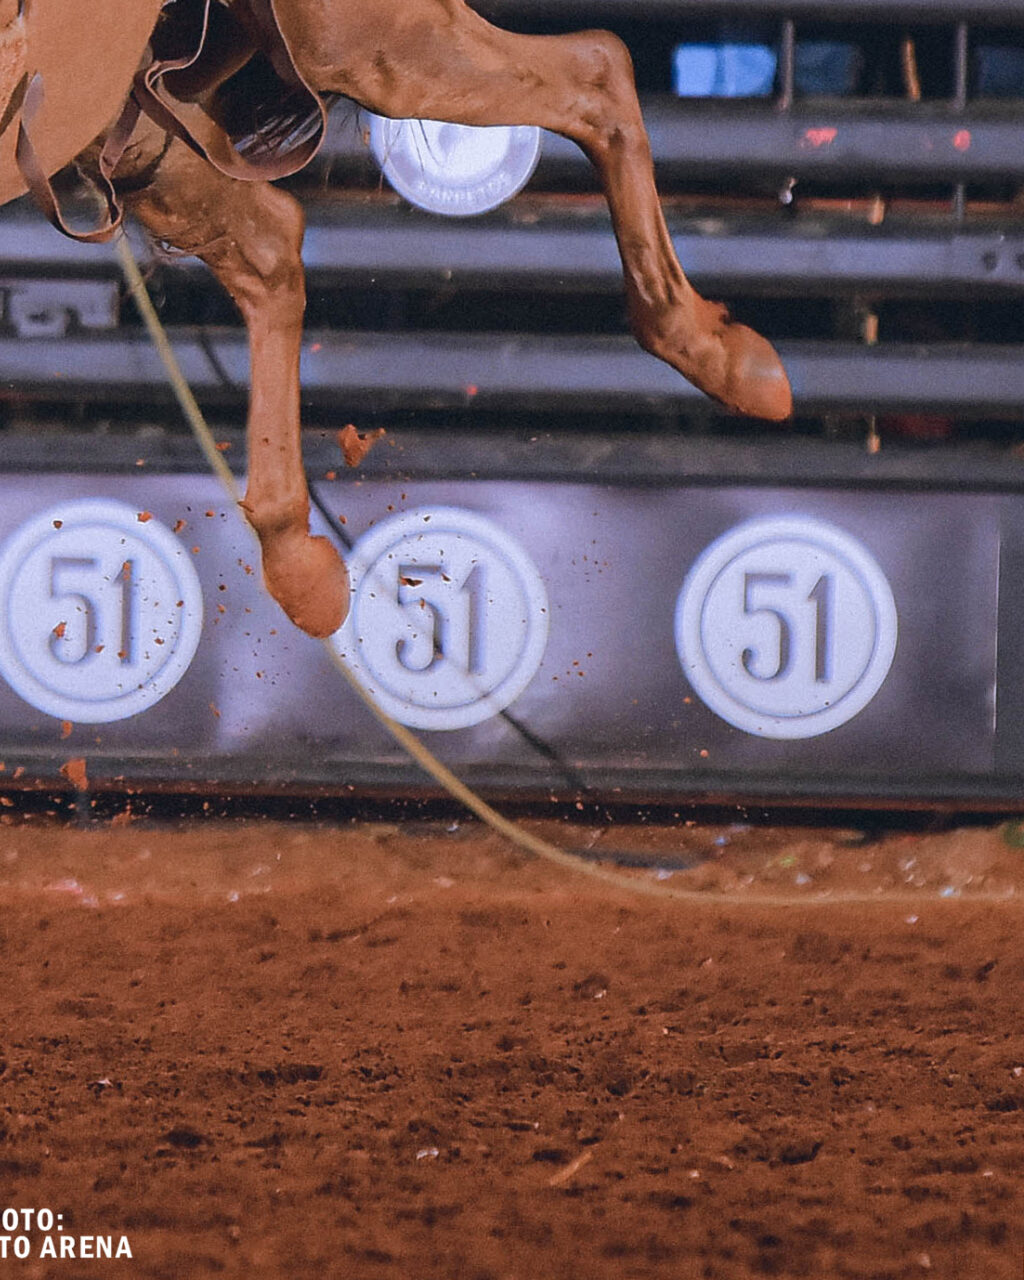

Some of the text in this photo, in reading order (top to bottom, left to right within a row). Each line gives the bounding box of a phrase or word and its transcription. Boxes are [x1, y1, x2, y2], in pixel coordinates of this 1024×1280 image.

[48, 556, 136, 667] 51
[395, 563, 487, 673] 51
[741, 572, 836, 683] 51
